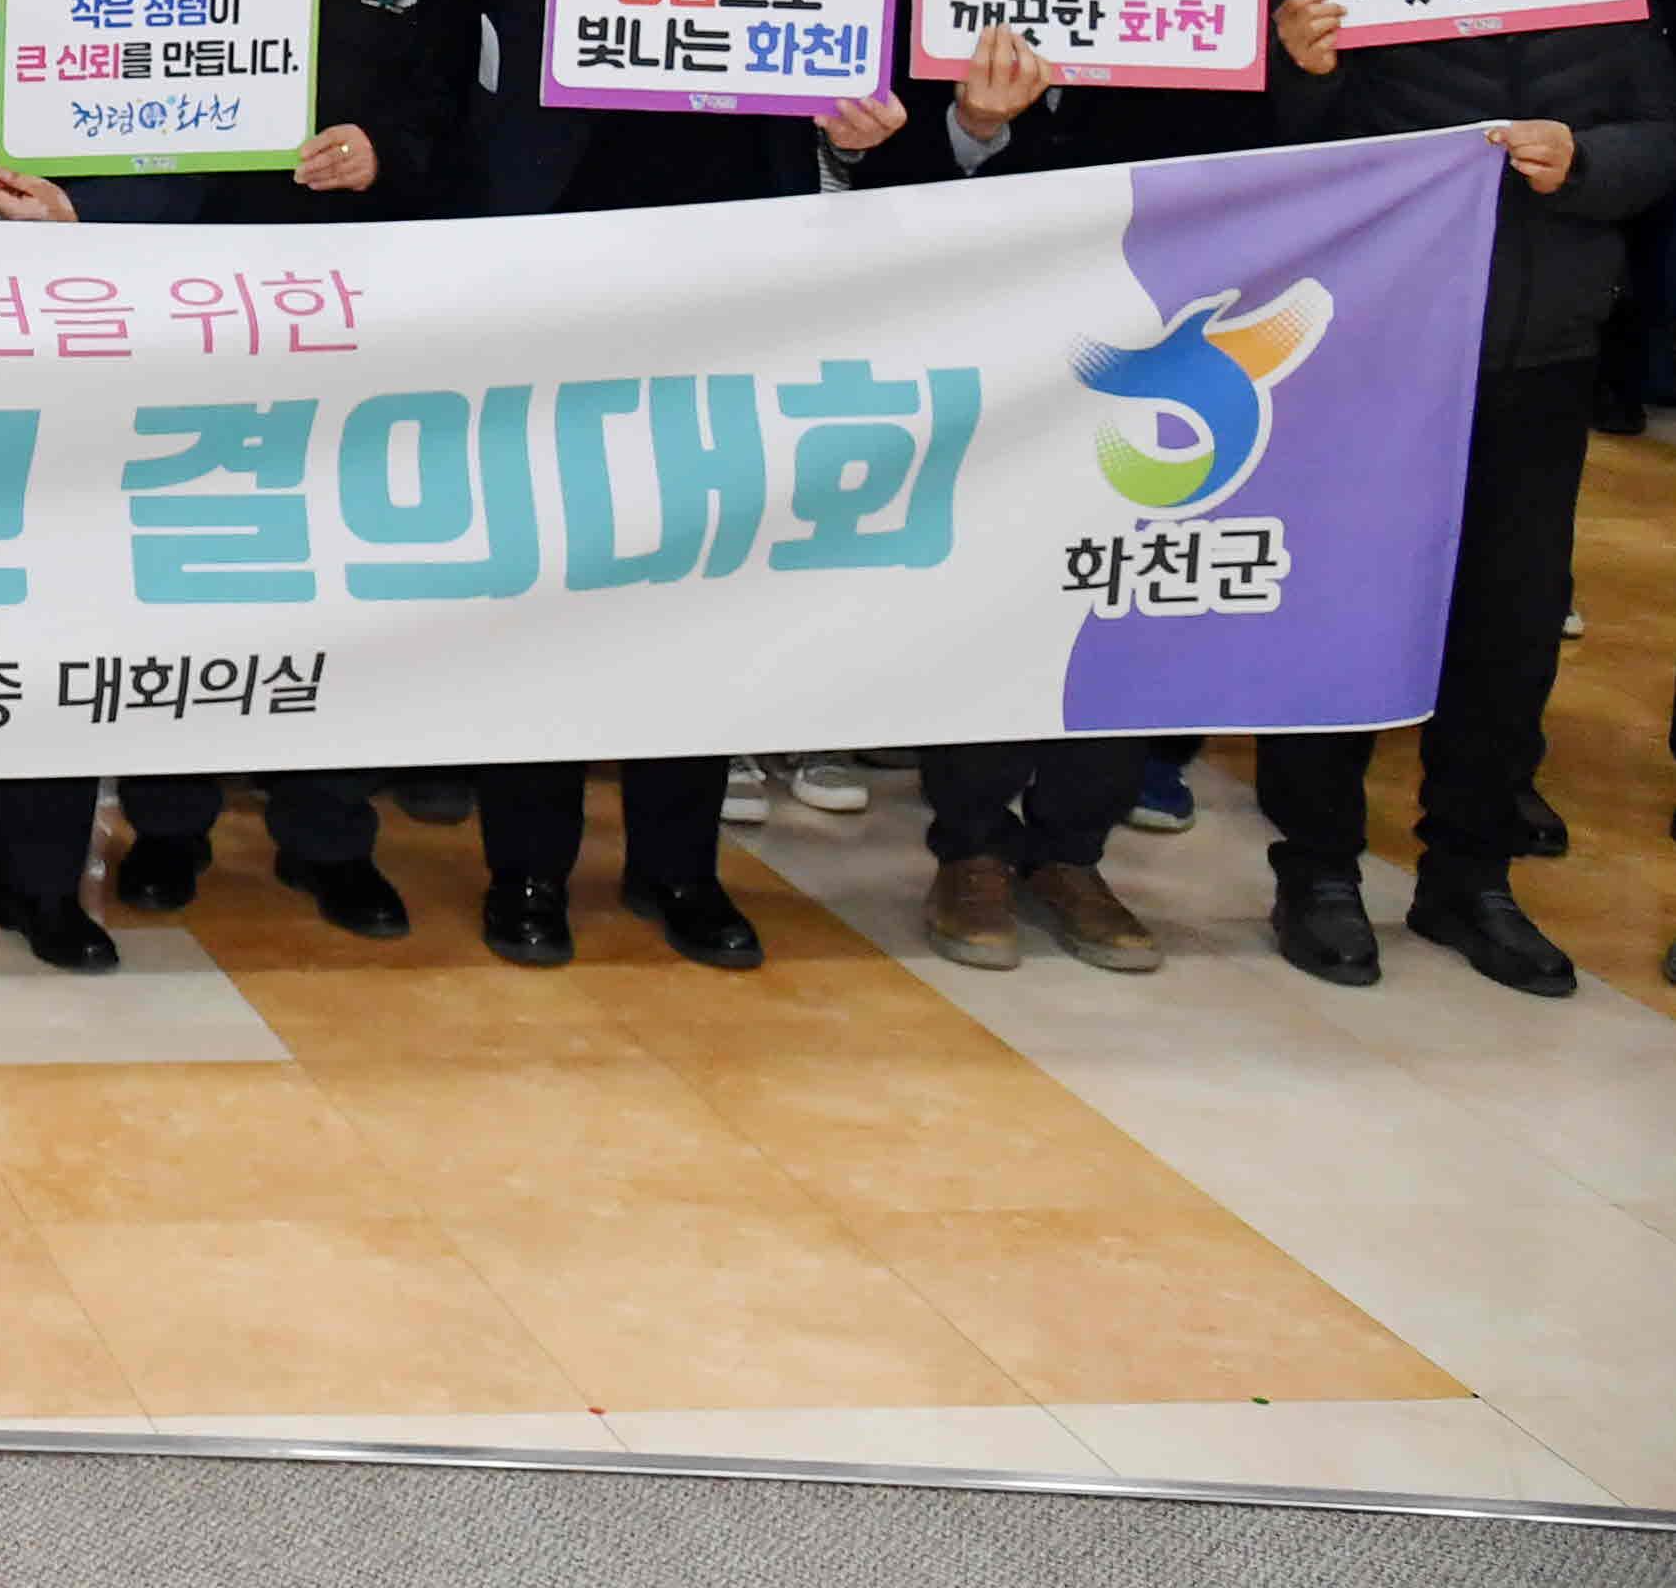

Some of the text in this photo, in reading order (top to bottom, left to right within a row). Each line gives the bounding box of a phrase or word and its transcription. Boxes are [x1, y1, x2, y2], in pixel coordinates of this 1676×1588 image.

[17, 38, 299, 83] 큰 신뢰를 만듭니다.
[577, 16, 869, 77] 빛나는 화천!
[1118, 0, 1226, 51] 화천
[170, 268, 366, 358] 위한
[121, 359, 981, 604] 결의대회
[1062, 528, 1277, 606] 화천군
[57, 652, 328, 724] 대회의실
